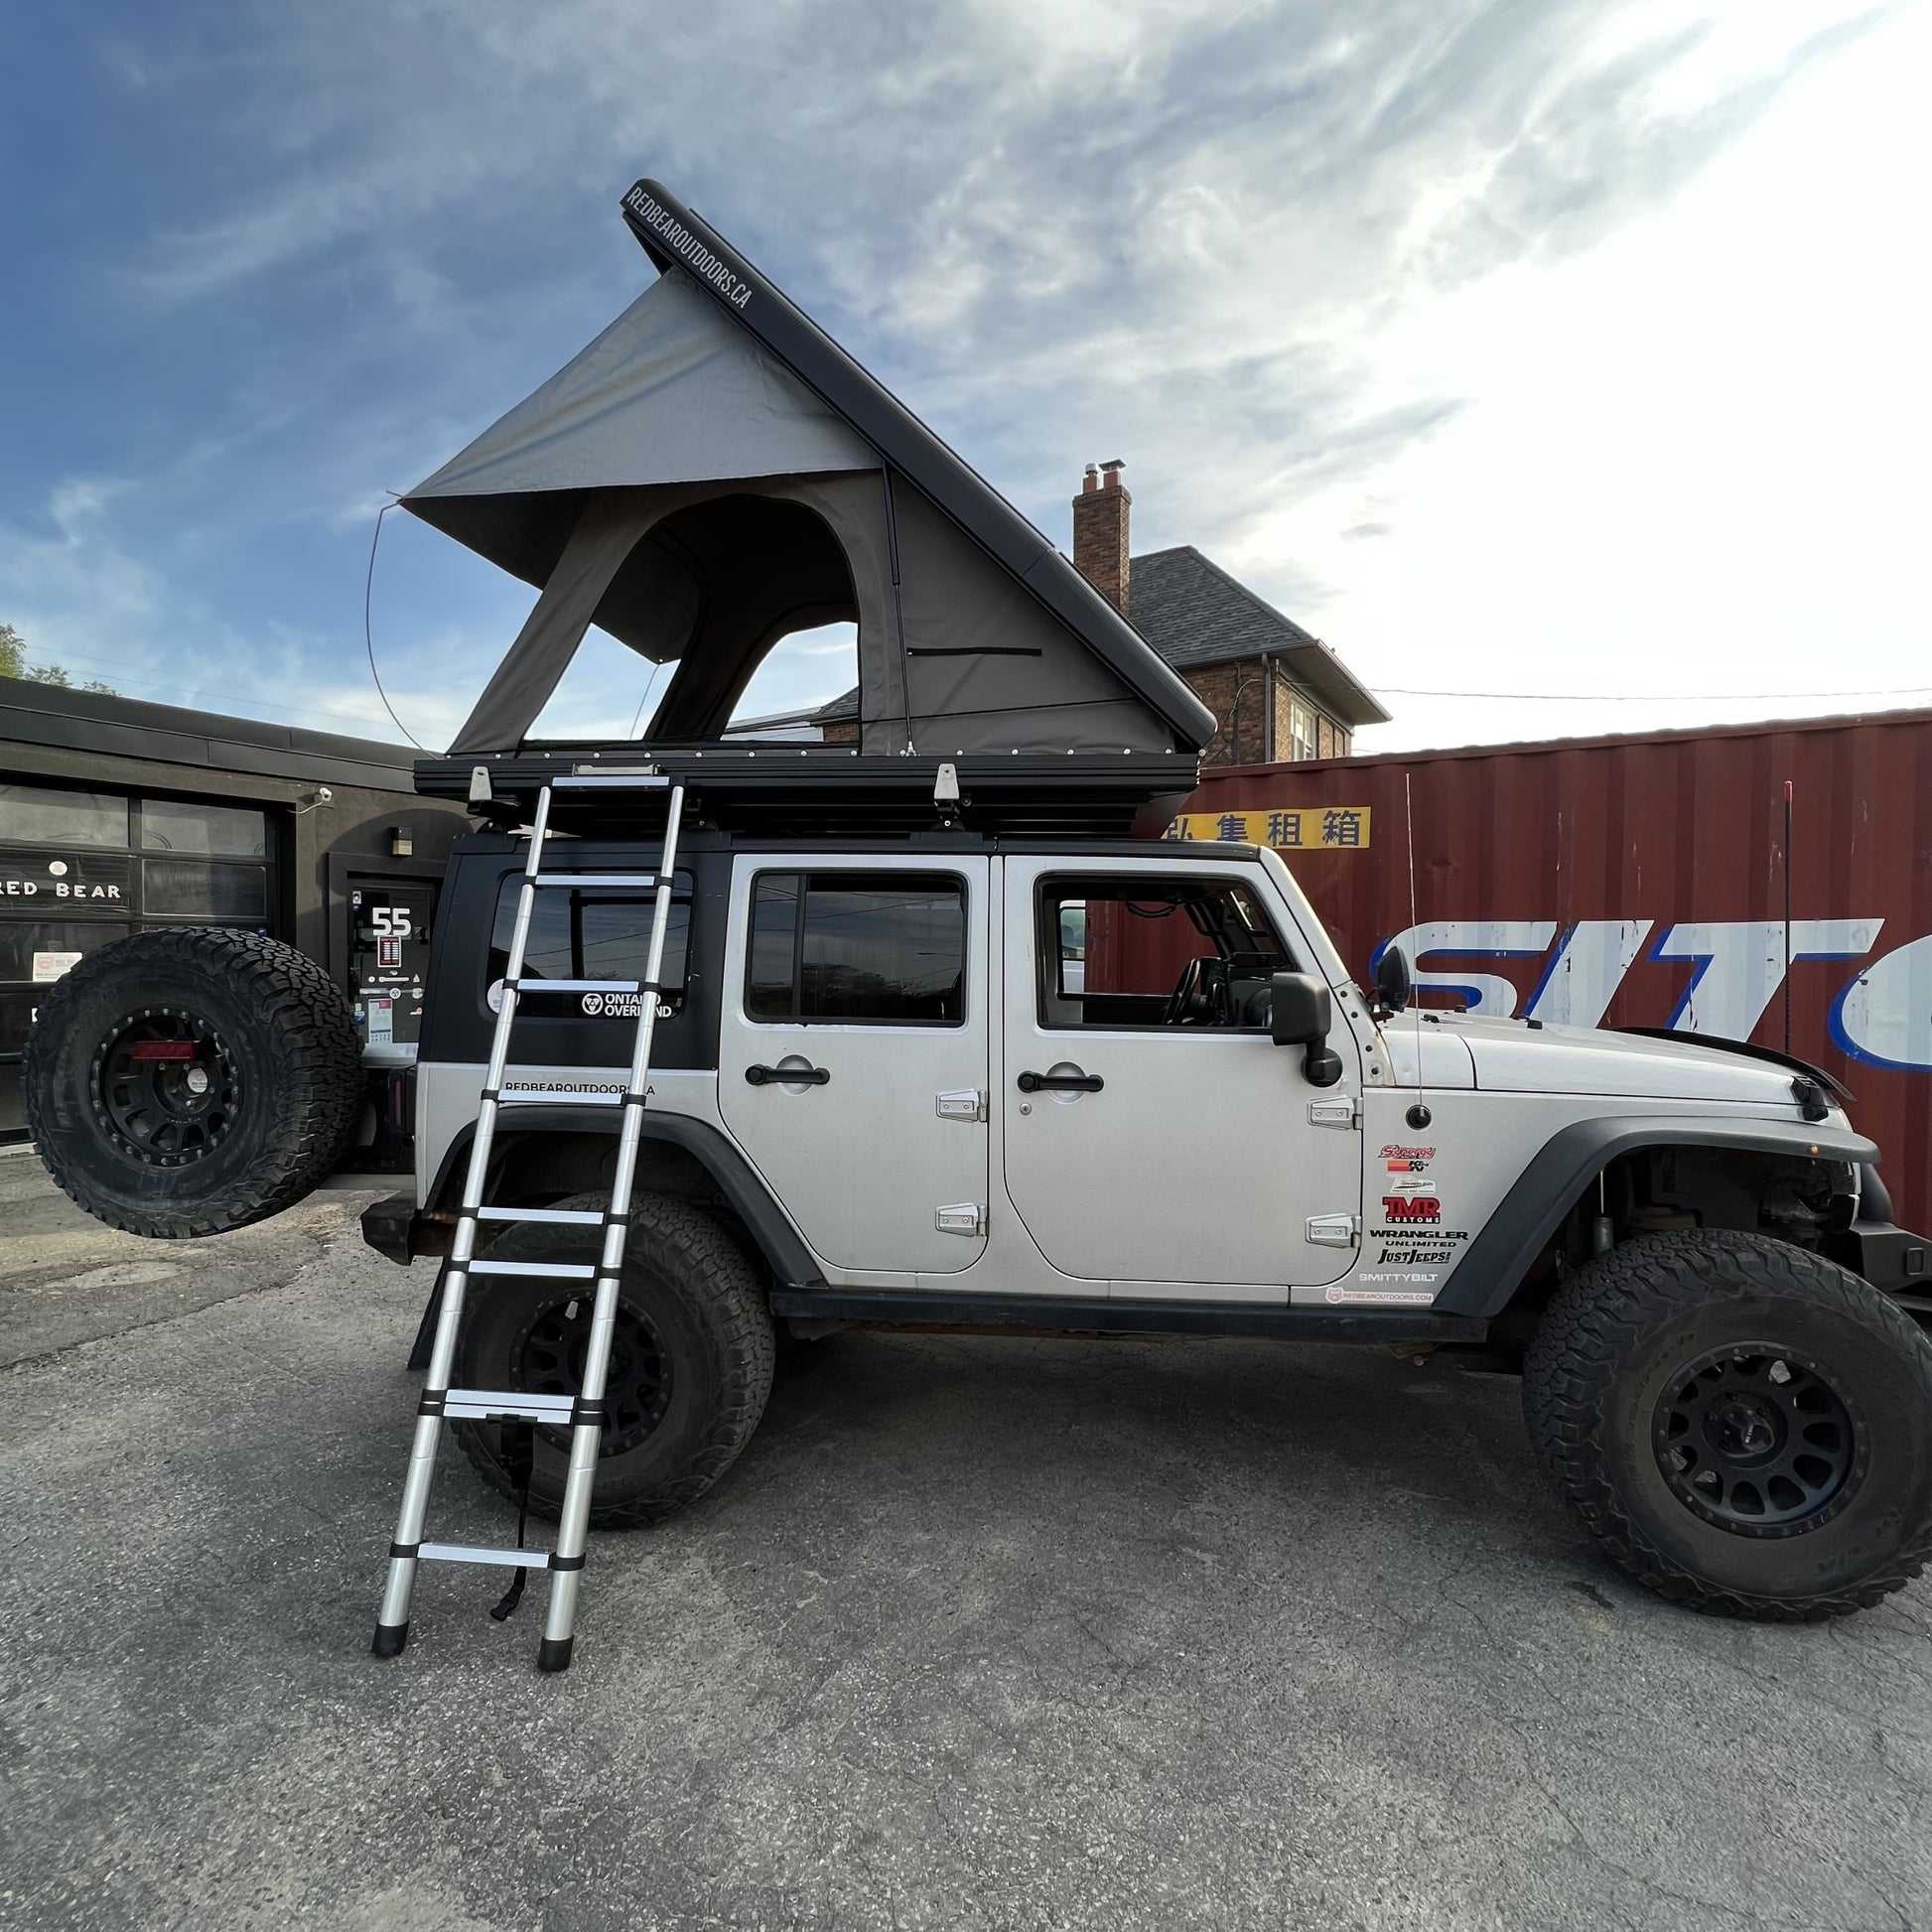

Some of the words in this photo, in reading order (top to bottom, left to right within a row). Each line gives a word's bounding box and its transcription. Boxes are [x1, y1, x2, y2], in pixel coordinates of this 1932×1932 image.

[625, 186, 753, 309] REDBEAROUTDOORS.CA
[56, 883, 121, 898] BEAR
[372, 907, 412, 936] 55
[605, 993, 662, 1005] ONTA
[604, 1005, 672, 1018] OVERND
[505, 1082, 656, 1095] REDBEAROUTDOORA
[1378, 1144, 1437, 1160] Synergy
[1381, 1196, 1441, 1217] TMR
[1369, 1229, 1469, 1241] WRANGLER
[1358, 1273, 1439, 1282] SMITTYBILT
[1342, 1293, 1433, 1304] REDBEAROUTDOORS.COM
